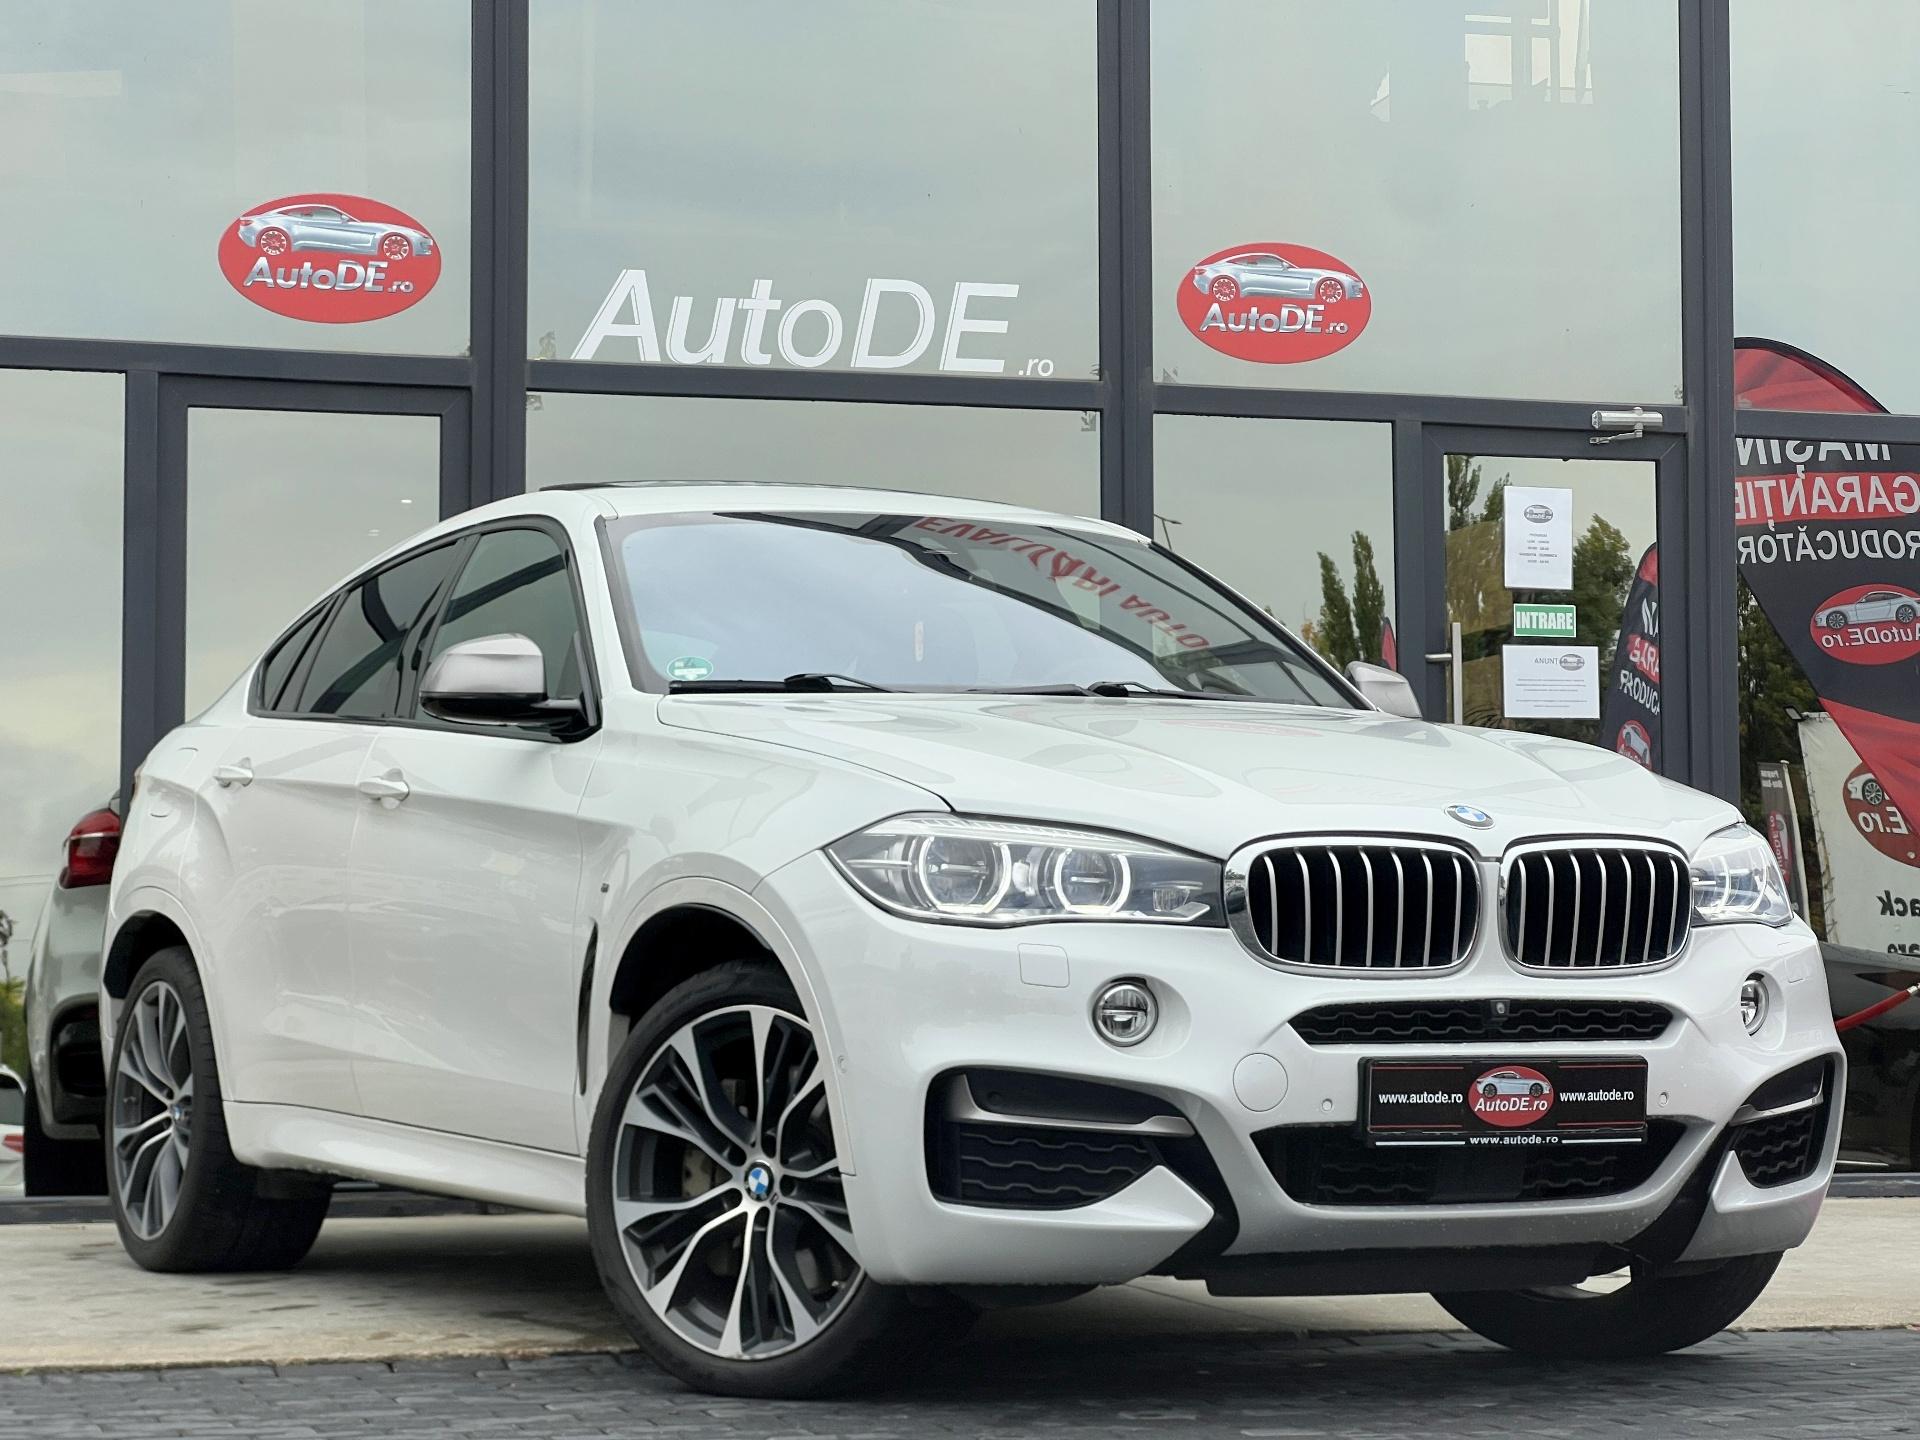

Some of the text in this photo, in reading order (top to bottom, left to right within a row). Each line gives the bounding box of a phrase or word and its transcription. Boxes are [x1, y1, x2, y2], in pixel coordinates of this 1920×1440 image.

[1516, 611, 1573, 630] INTRARE
[1378, 1090, 1464, 1104] www.autode.ro
[1559, 1088, 1635, 1103] www.autode.ro
[1474, 1097, 1548, 1113] AutoDE.ro
[1469, 1134, 1559, 1145] www.autode.ro
